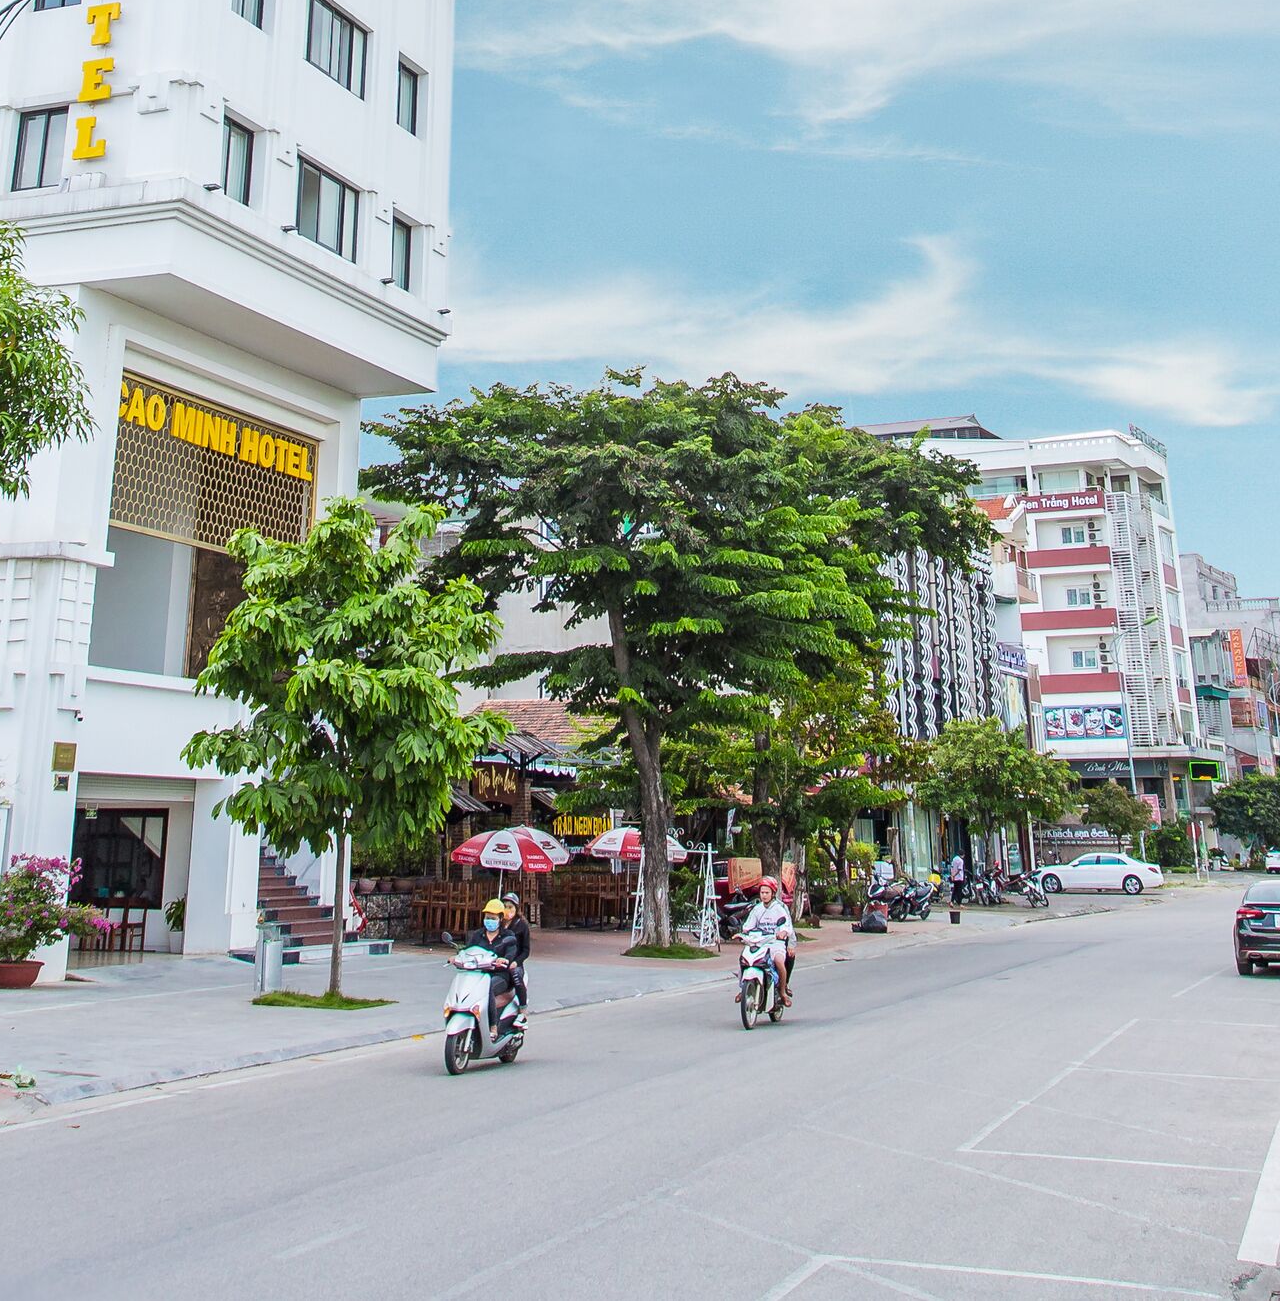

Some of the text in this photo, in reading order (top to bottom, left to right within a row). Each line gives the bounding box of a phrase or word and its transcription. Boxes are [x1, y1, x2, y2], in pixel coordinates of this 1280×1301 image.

[171, 402, 237, 457] MINH
[239, 427, 313, 482] HOTEL
[1020, 494, 1098, 509] Sen Trắng Hotel
[573, 816, 593, 836] NGON
